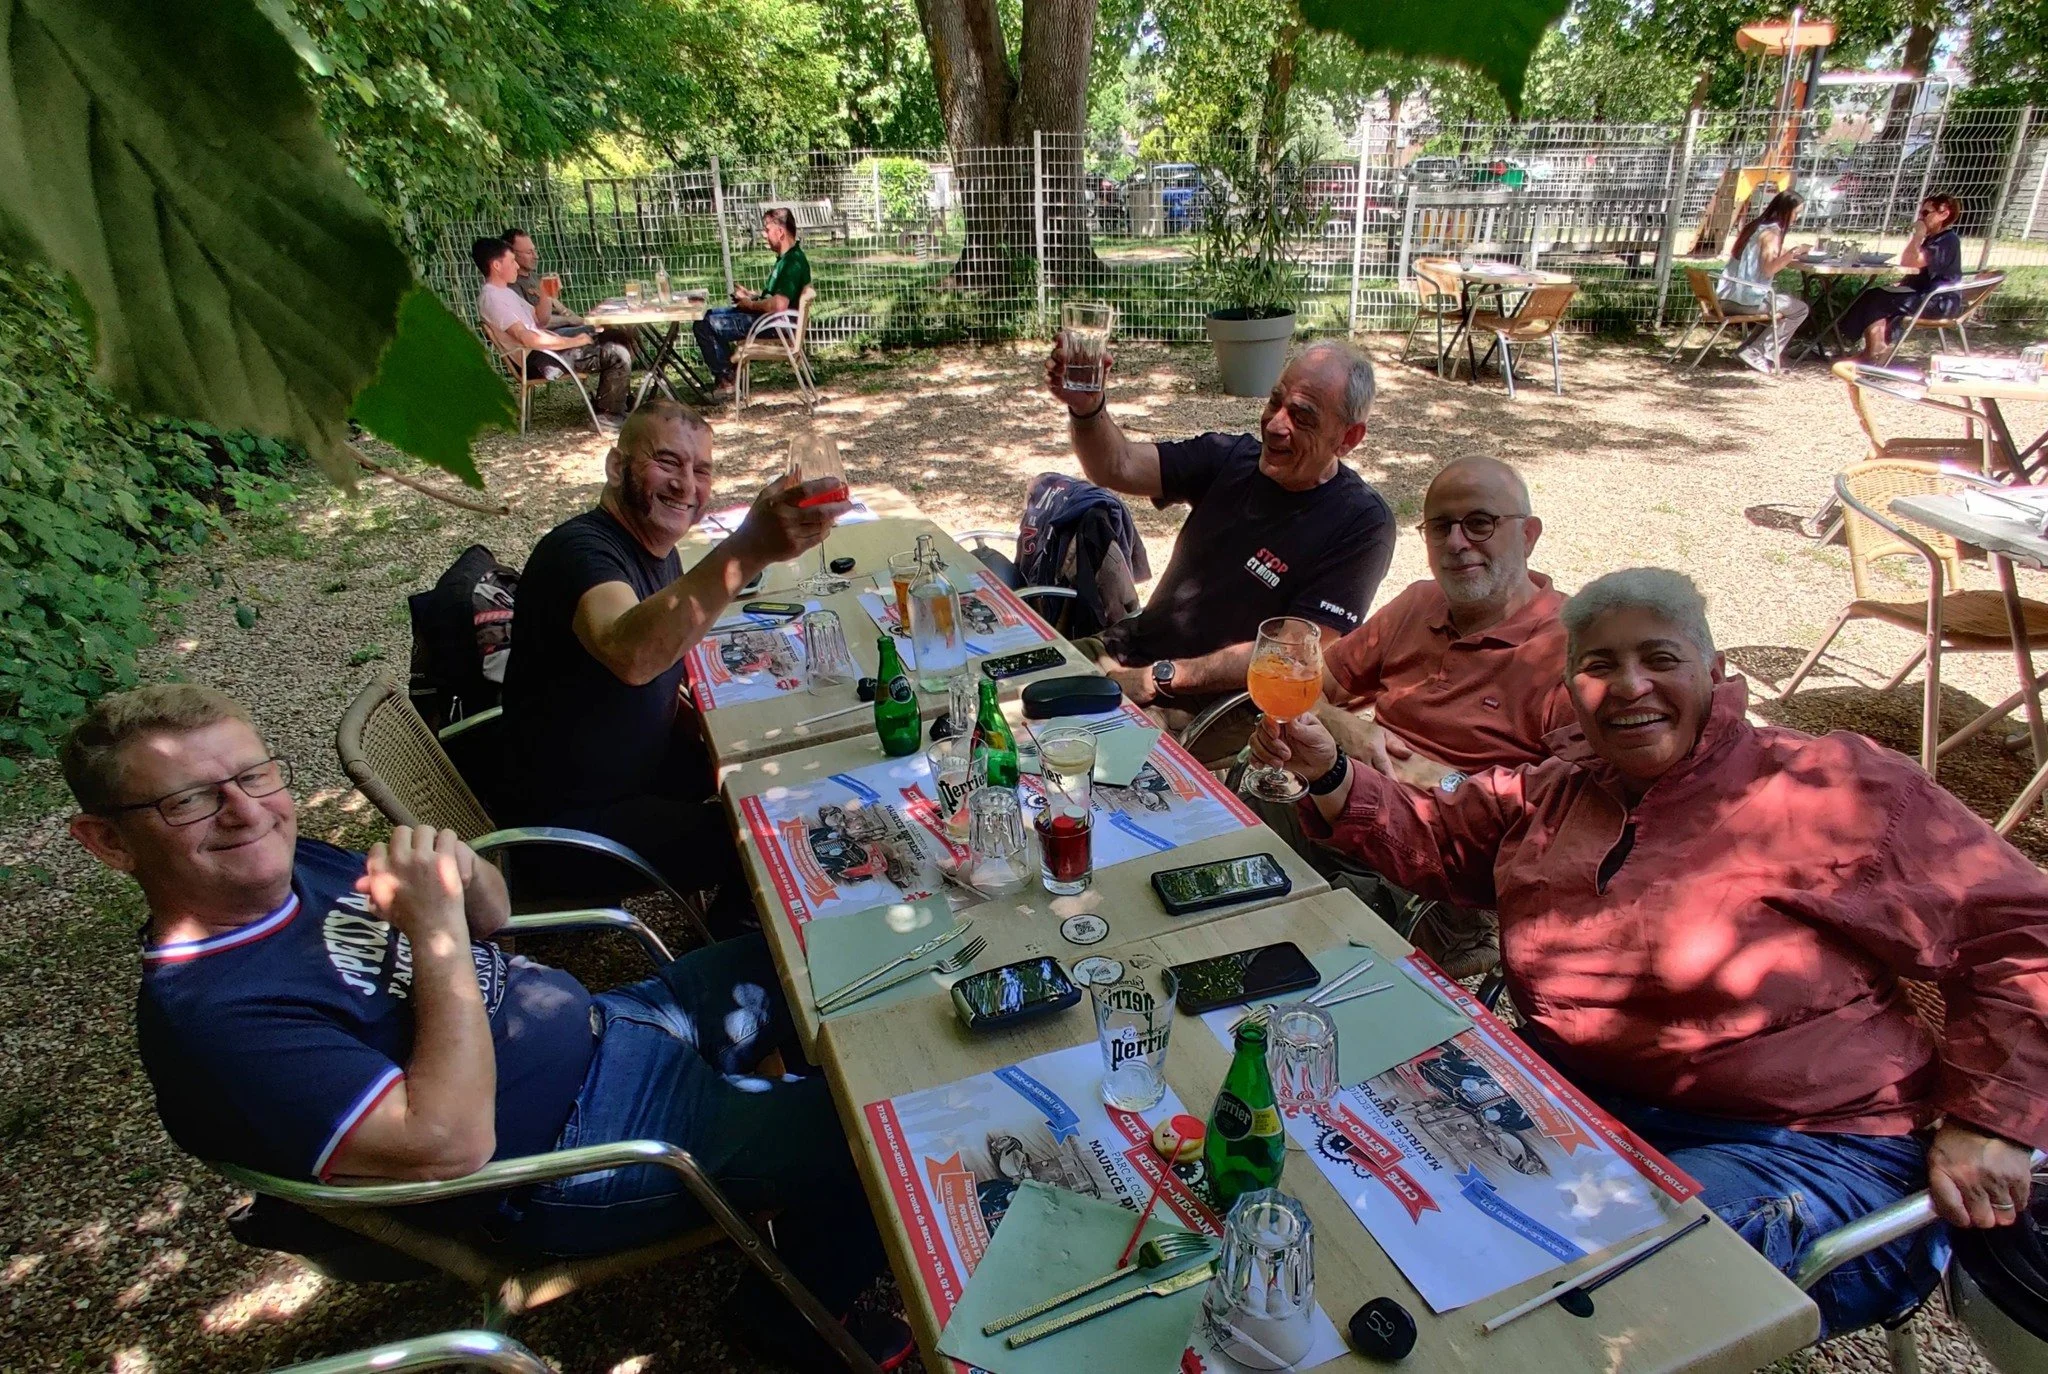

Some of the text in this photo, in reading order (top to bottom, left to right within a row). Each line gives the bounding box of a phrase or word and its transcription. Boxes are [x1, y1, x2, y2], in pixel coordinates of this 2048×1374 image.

[1246, 556, 1280, 588] CT MOTO
[1256, 548, 1289, 574] STOP
[1320, 600, 1358, 623] FFMC 14
[884, 804, 905, 830] MAURICE
[901, 829, 925, 861] DUFRESNE
[322, 910, 391, 996] J'PEUX
[1538, 1069, 1563, 1092] Marnay
[1562, 1090, 1572, 1100] de
[1215, 1095, 1251, 1126] Perrier
[1571, 1098, 1592, 1117] route
[1120, 1114, 1149, 1141] CITÉ
[883, 1122, 909, 1178] AZAY-LE-RIDEAU
[1391, 1119, 1444, 1172] MAURICE
[1392, 1136, 1413, 1160] PARC
[1605, 1129, 1665, 1176] AZAY-LE-RIDEAU
[1089, 1139, 1128, 1195] MAURICE
[1112, 1151, 1131, 1174] PARC
[1384, 1170, 1419, 1201] CITÉ
[1663, 1174, 1689, 1195] 37190
[908, 1194, 921, 1215] route
[916, 1215, 926, 1226] de
[1496, 1211, 1568, 1256] AZAY-LE-RIDEAU
[920, 1225, 936, 1256] Marnay
